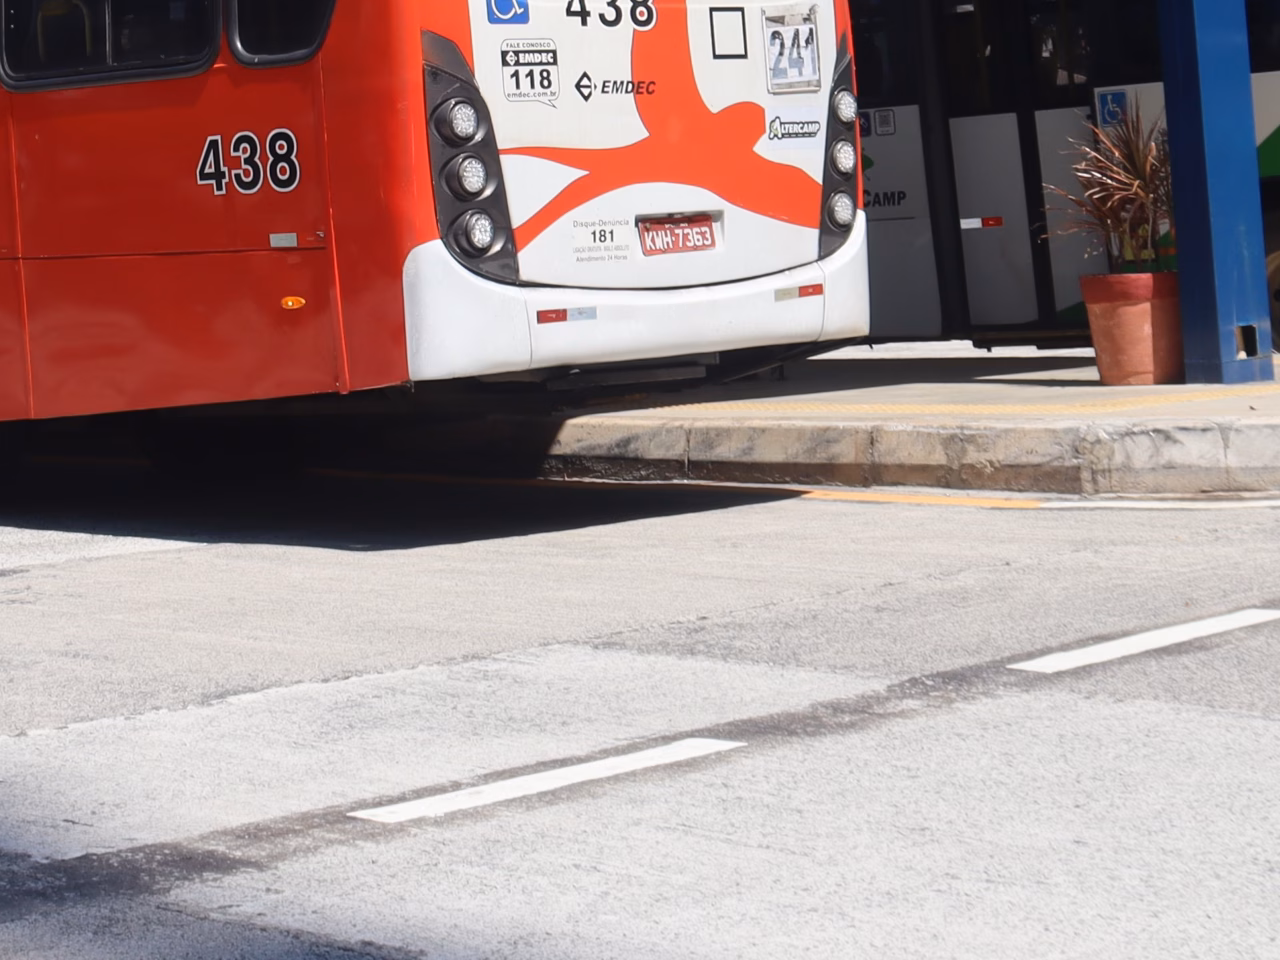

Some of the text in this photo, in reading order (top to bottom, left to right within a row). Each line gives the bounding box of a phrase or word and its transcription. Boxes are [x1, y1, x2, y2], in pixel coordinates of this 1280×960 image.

[519, 52, 554, 63] EMDEC
[769, 27, 818, 79] 241
[510, 69, 553, 90] 118
[507, 90, 557, 99] emdec.com.br
[601, 80, 656, 95] EMDEC
[196, 128, 300, 195] 438
[573, 219, 629, 228] Disque-Denúncia
[591, 228, 615, 243] 181
